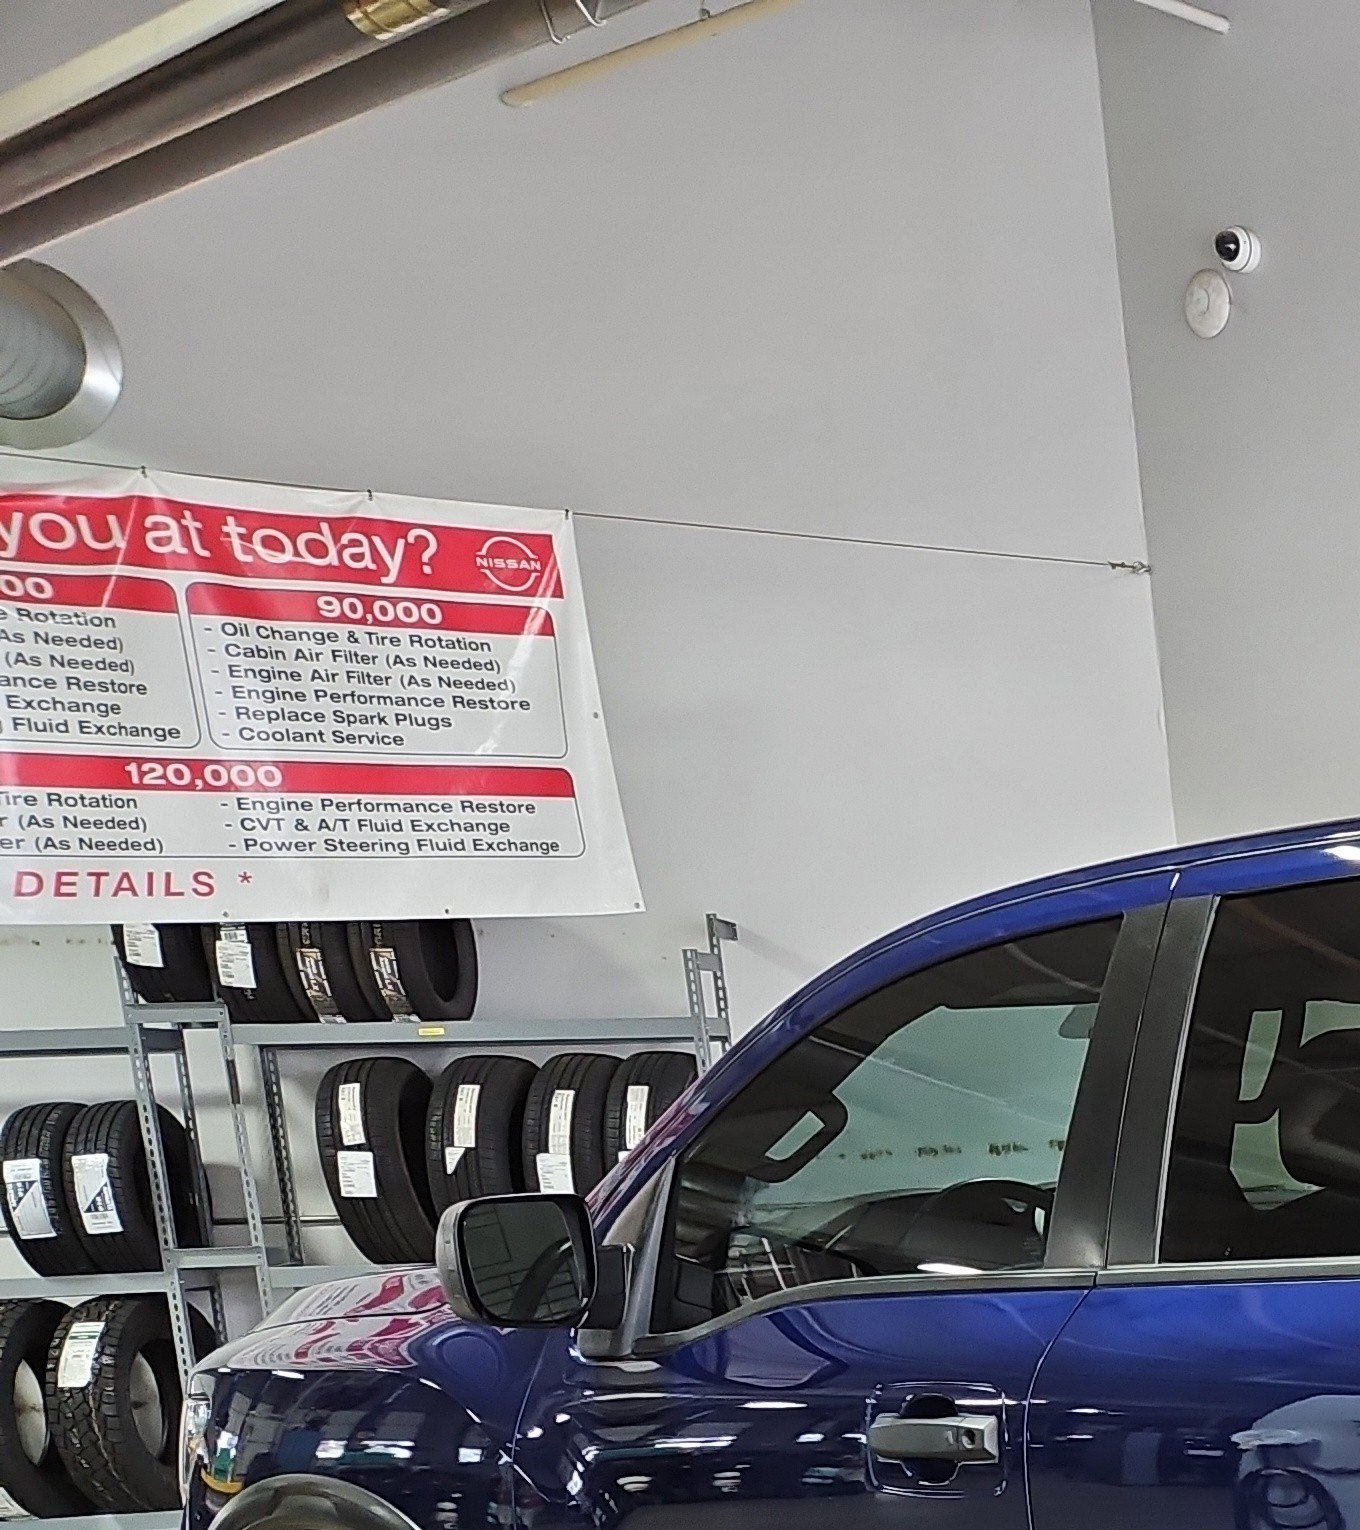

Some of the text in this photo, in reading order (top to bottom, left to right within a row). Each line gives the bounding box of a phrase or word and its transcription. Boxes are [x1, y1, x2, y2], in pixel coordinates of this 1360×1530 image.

[0, 509, 438, 584] you at today?
[475, 556, 542, 571] NISSAN
[16, 607, 117, 628] Rotation
[316, 595, 443, 625] 90,000
[34, 630, 124, 654] Needed)
[220, 622, 492, 653] Oil Change & Tire Rotation
[5, 651, 136, 677] (As Needed)
[224, 643, 501, 675] Cabin Air Filter (As Needed)
[66, 676, 148, 695] Restore
[228, 664, 516, 694] Engine Air Filter (As Needed)
[5, 694, 122, 718] Exchange
[231, 685, 531, 711] Engine Performance Restore
[12, 716, 181, 742] Fluid Exchange
[234, 705, 453, 731] Replace Spark Plugs
[238, 726, 405, 746] Coolant Service
[124, 761, 284, 791] 120,000
[46, 792, 138, 809] Rotation
[235, 796, 536, 815] Engine Performance Restore
[18, 814, 55, 831] (As
[62, 815, 148, 833] Needed)
[240, 817, 511, 836] CVT & A/T Fluid Exchange
[35, 836, 71, 853] (As
[78, 837, 164, 854] Needed)
[243, 837, 560, 856] Power Steering Fluid Exchange
[13, 870, 216, 898] DETAILS
